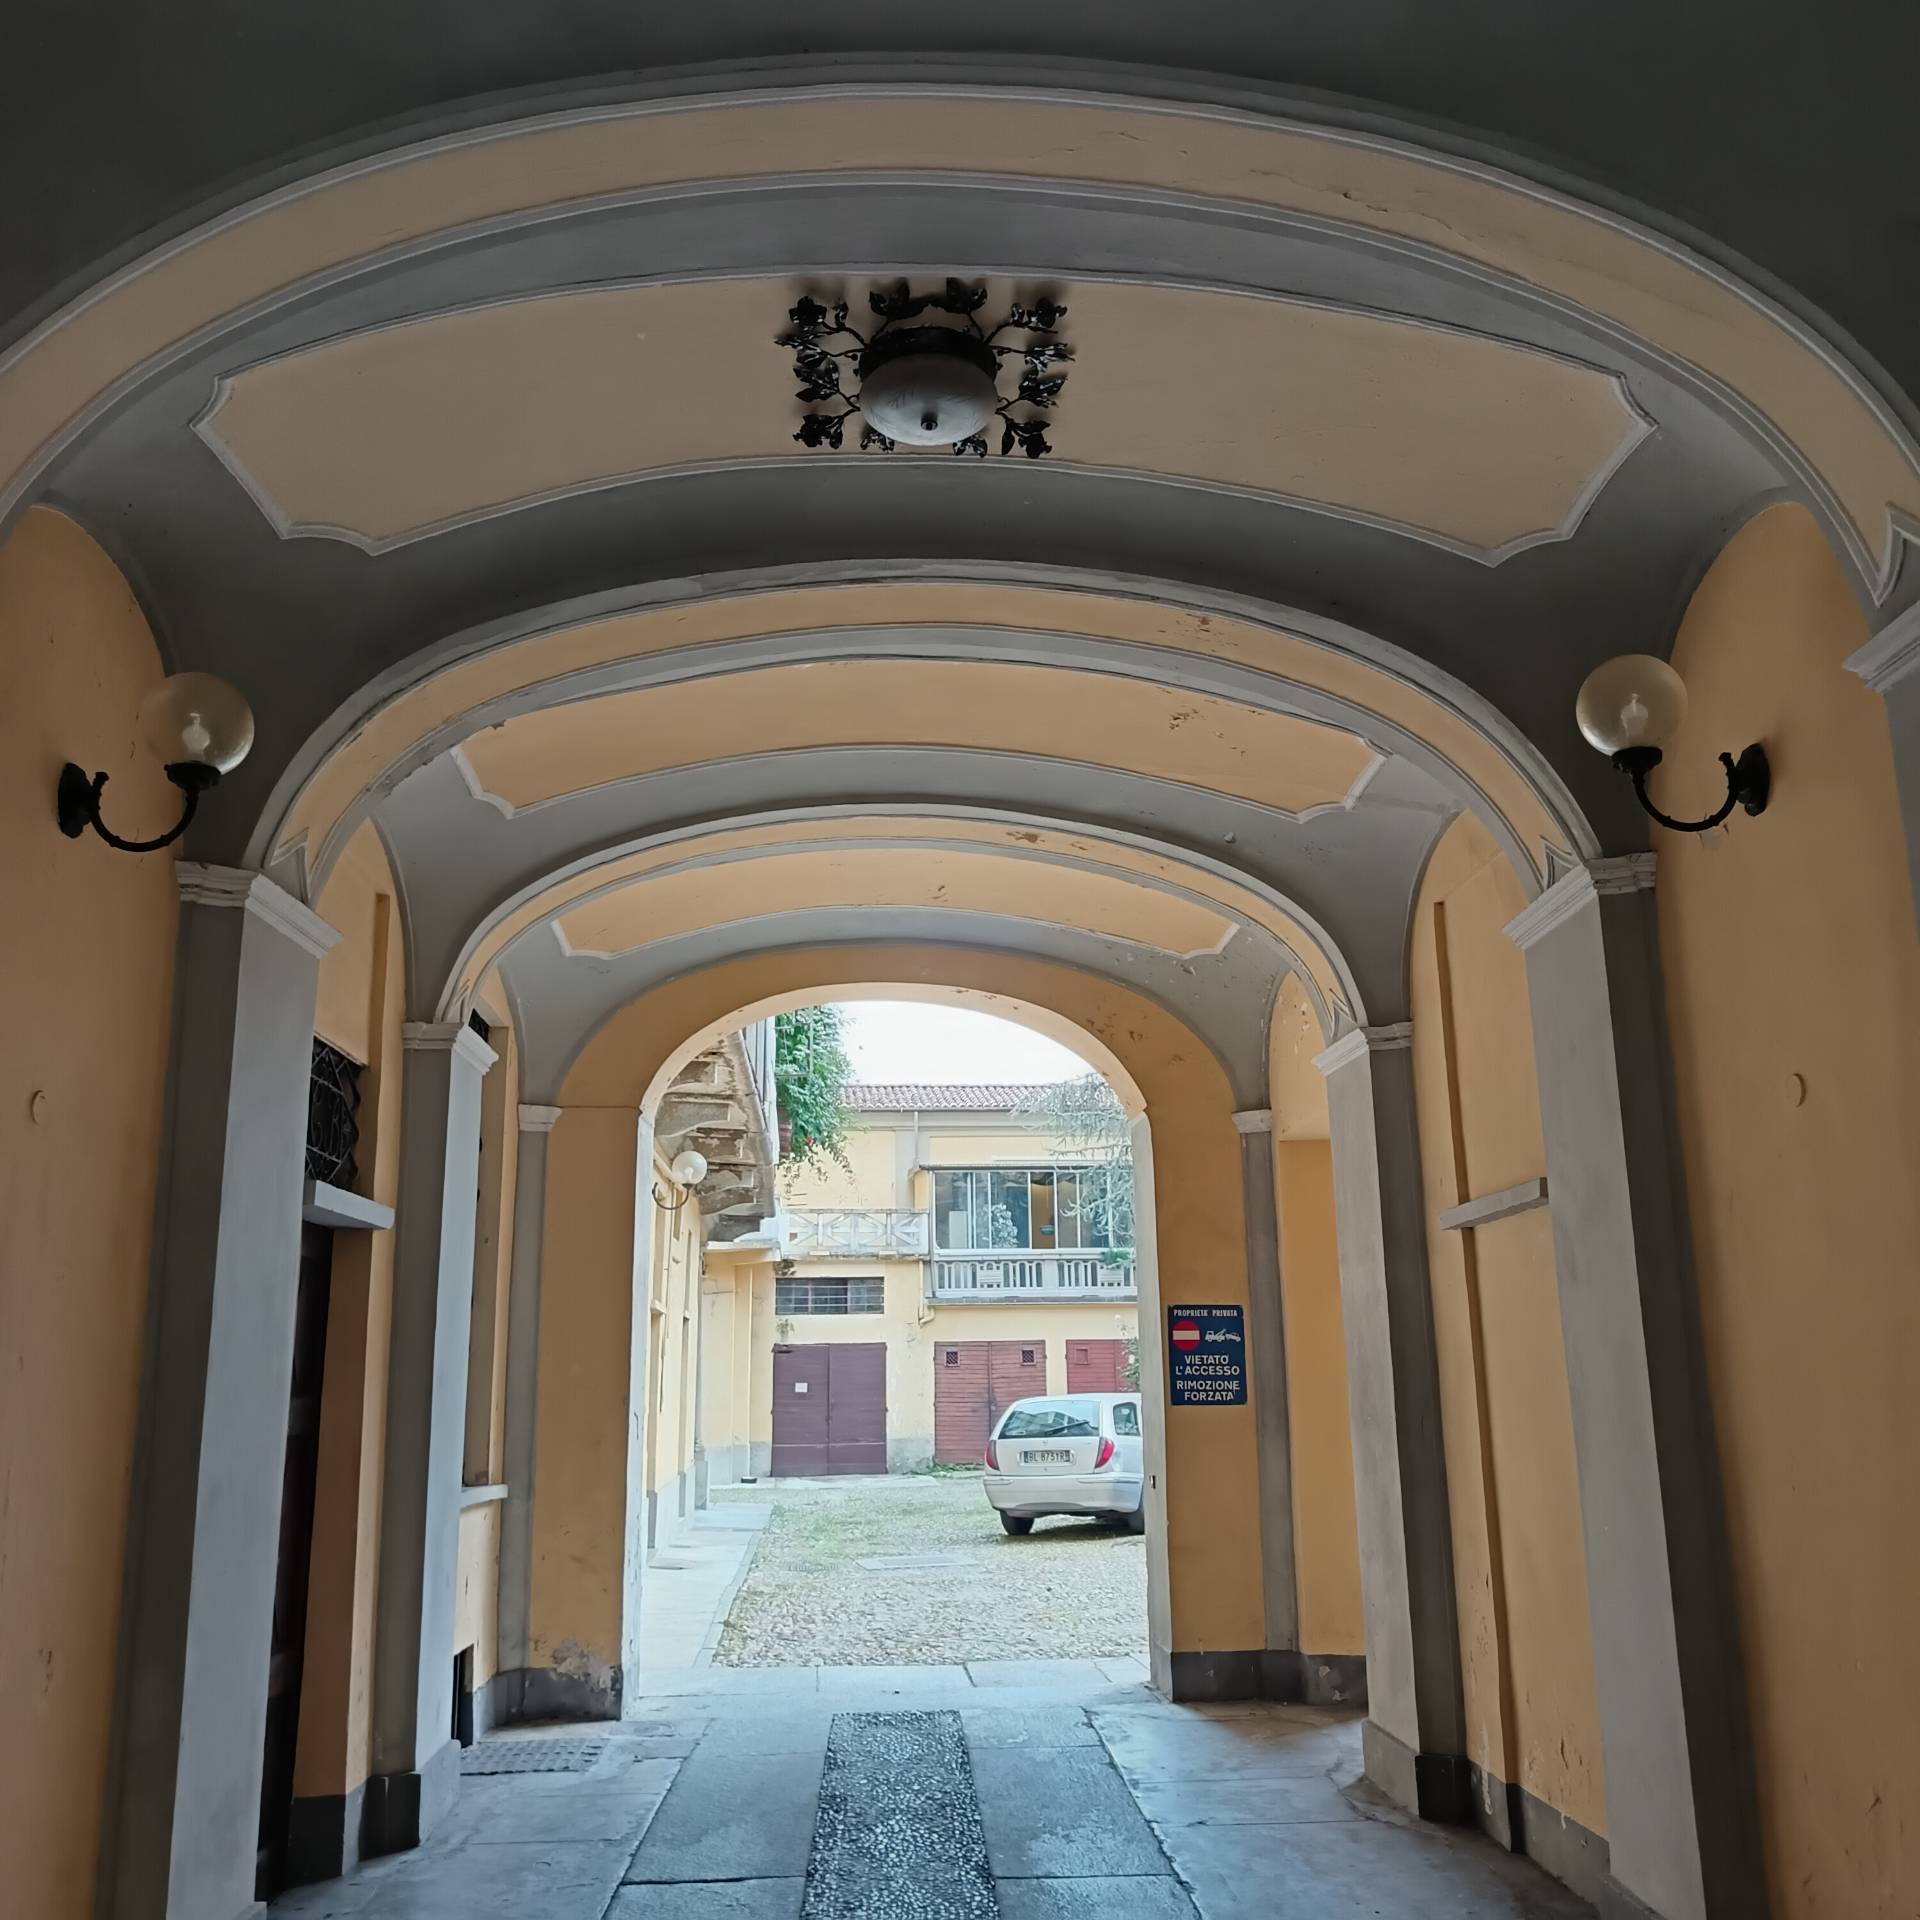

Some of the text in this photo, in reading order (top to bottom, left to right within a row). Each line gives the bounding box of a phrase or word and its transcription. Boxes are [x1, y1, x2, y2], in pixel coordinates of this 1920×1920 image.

[1212, 1309, 1238, 1317] PRIVATA
[1184, 1355, 1229, 1365] VIETATO
[1175, 1366, 1240, 1376] L'ACCESSO
[1176, 1381, 1240, 1390] RIMOZIONE
[1184, 1391, 1234, 1401] FORZATA
